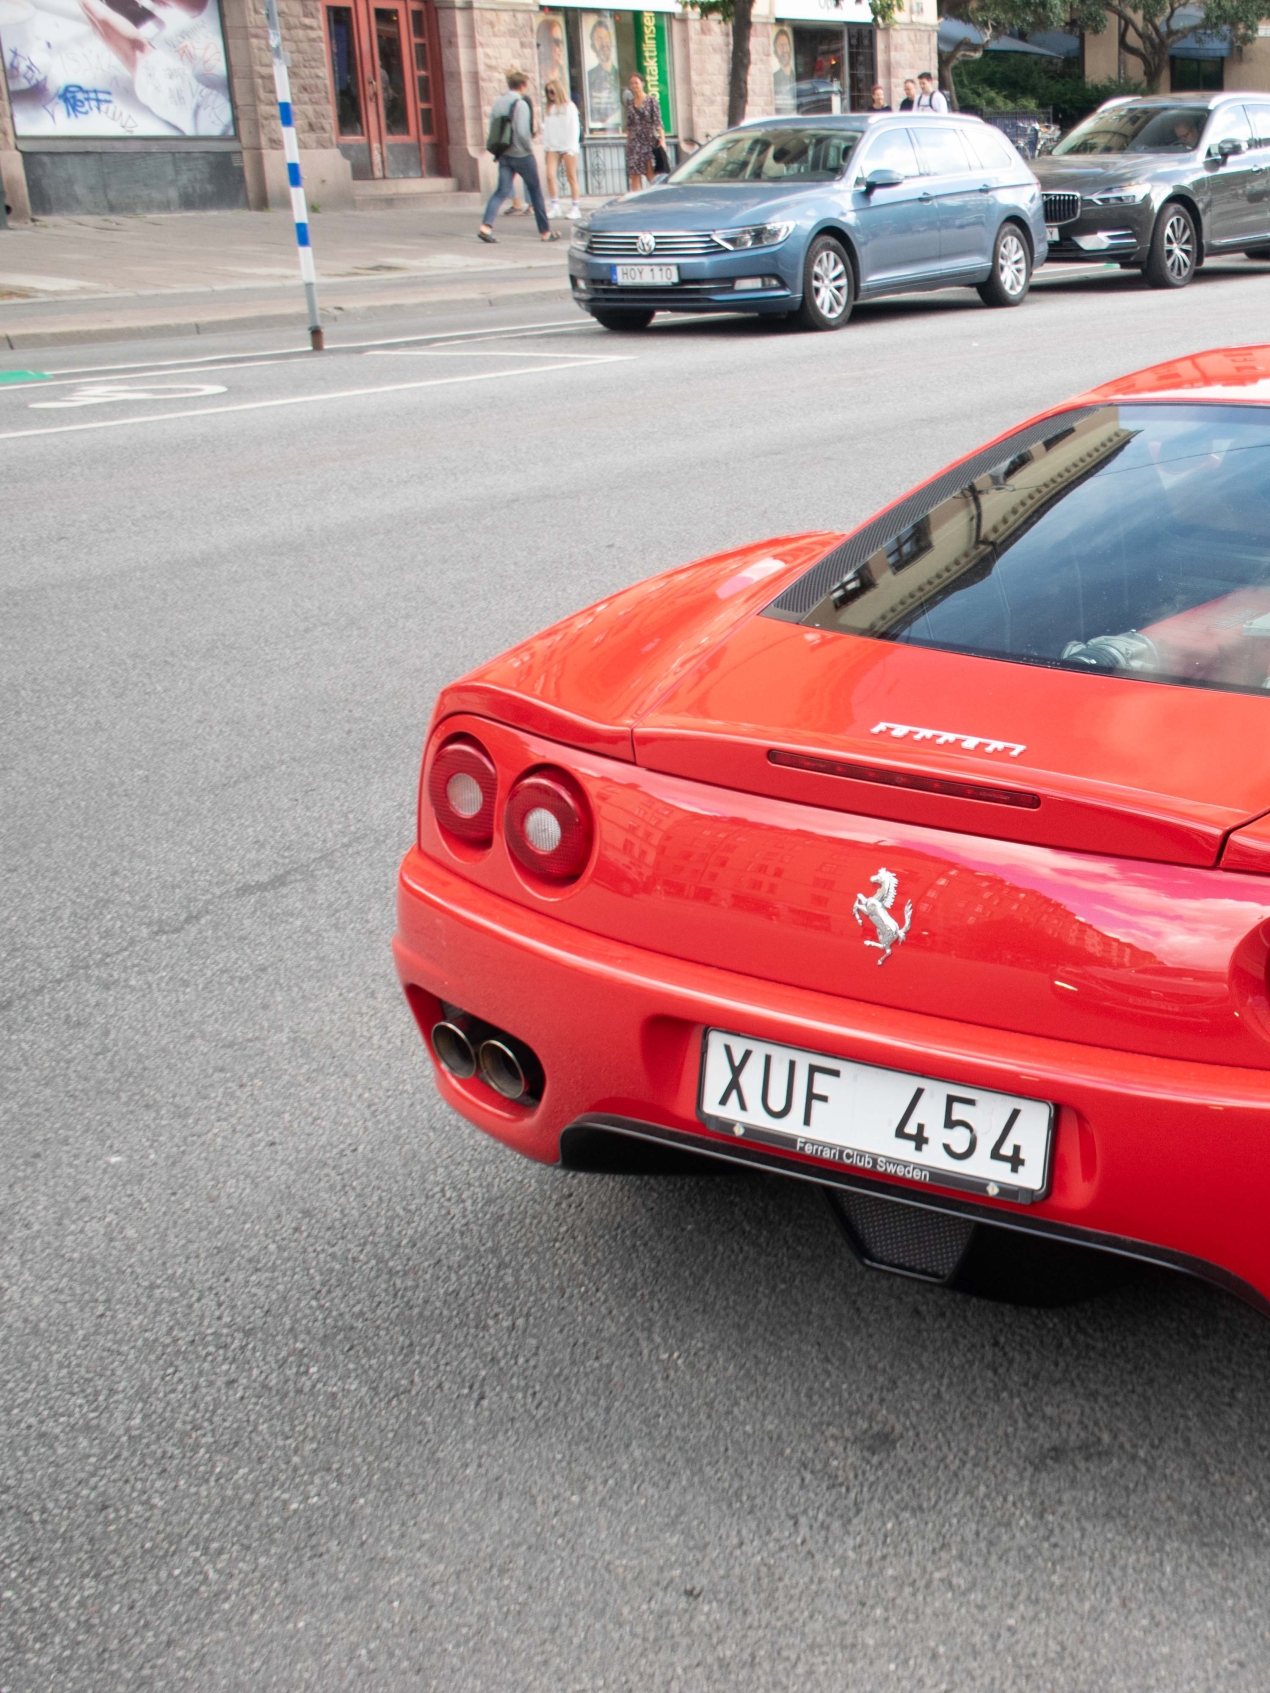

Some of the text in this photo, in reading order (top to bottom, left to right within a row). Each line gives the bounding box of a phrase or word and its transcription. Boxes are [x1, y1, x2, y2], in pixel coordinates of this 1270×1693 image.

[621, 267, 673, 281] HOY 110
[870, 721, 1027, 757] Ferrari
[718, 1043, 1026, 1174] XUF 454
[796, 1137, 930, 1182] Ferrari Club Sweden
